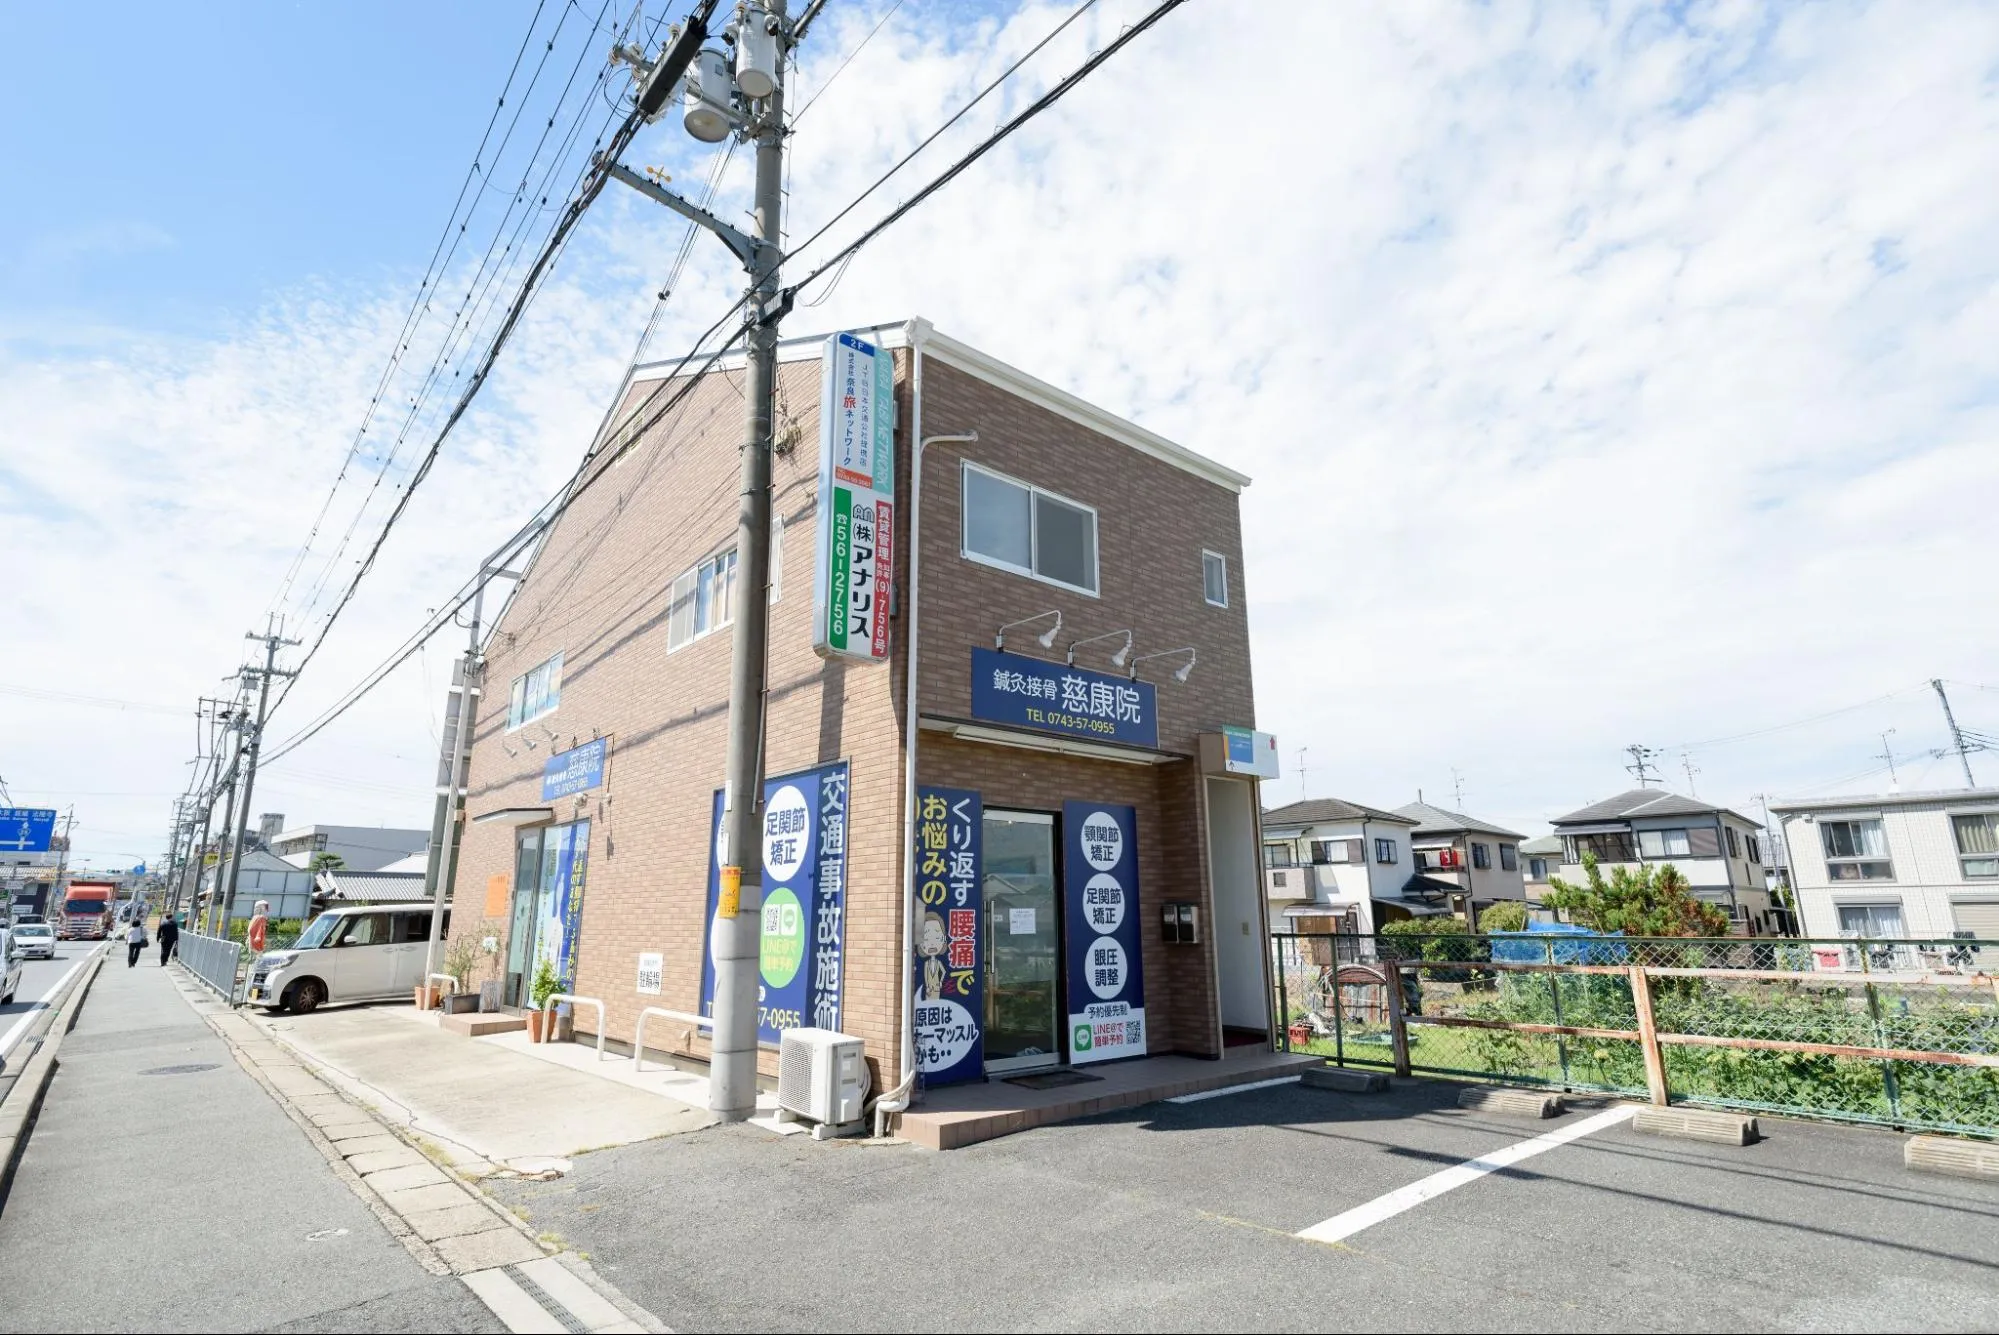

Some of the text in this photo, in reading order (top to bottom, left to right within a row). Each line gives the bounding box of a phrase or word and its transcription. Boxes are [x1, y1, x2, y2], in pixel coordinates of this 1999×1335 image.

[850, 339, 865, 350] 2F
[1061, 674, 1141, 724] 慈康院
[1026, 708, 1115, 735] TEL 0743-57-0955
[765, 807, 806, 837] 足関節
[770, 838, 797, 866] 矯正
[922, 794, 948, 905] お悩みの
[1091, 844, 1114, 862] 矯正
[813, 772, 845, 1032] 交通事故施術
[1086, 887, 1121, 905] 足関節
[1093, 907, 1117, 925] 矯正
[1095, 948, 1118, 966] 眼圧
[1095, 968, 1119, 987] 調整
